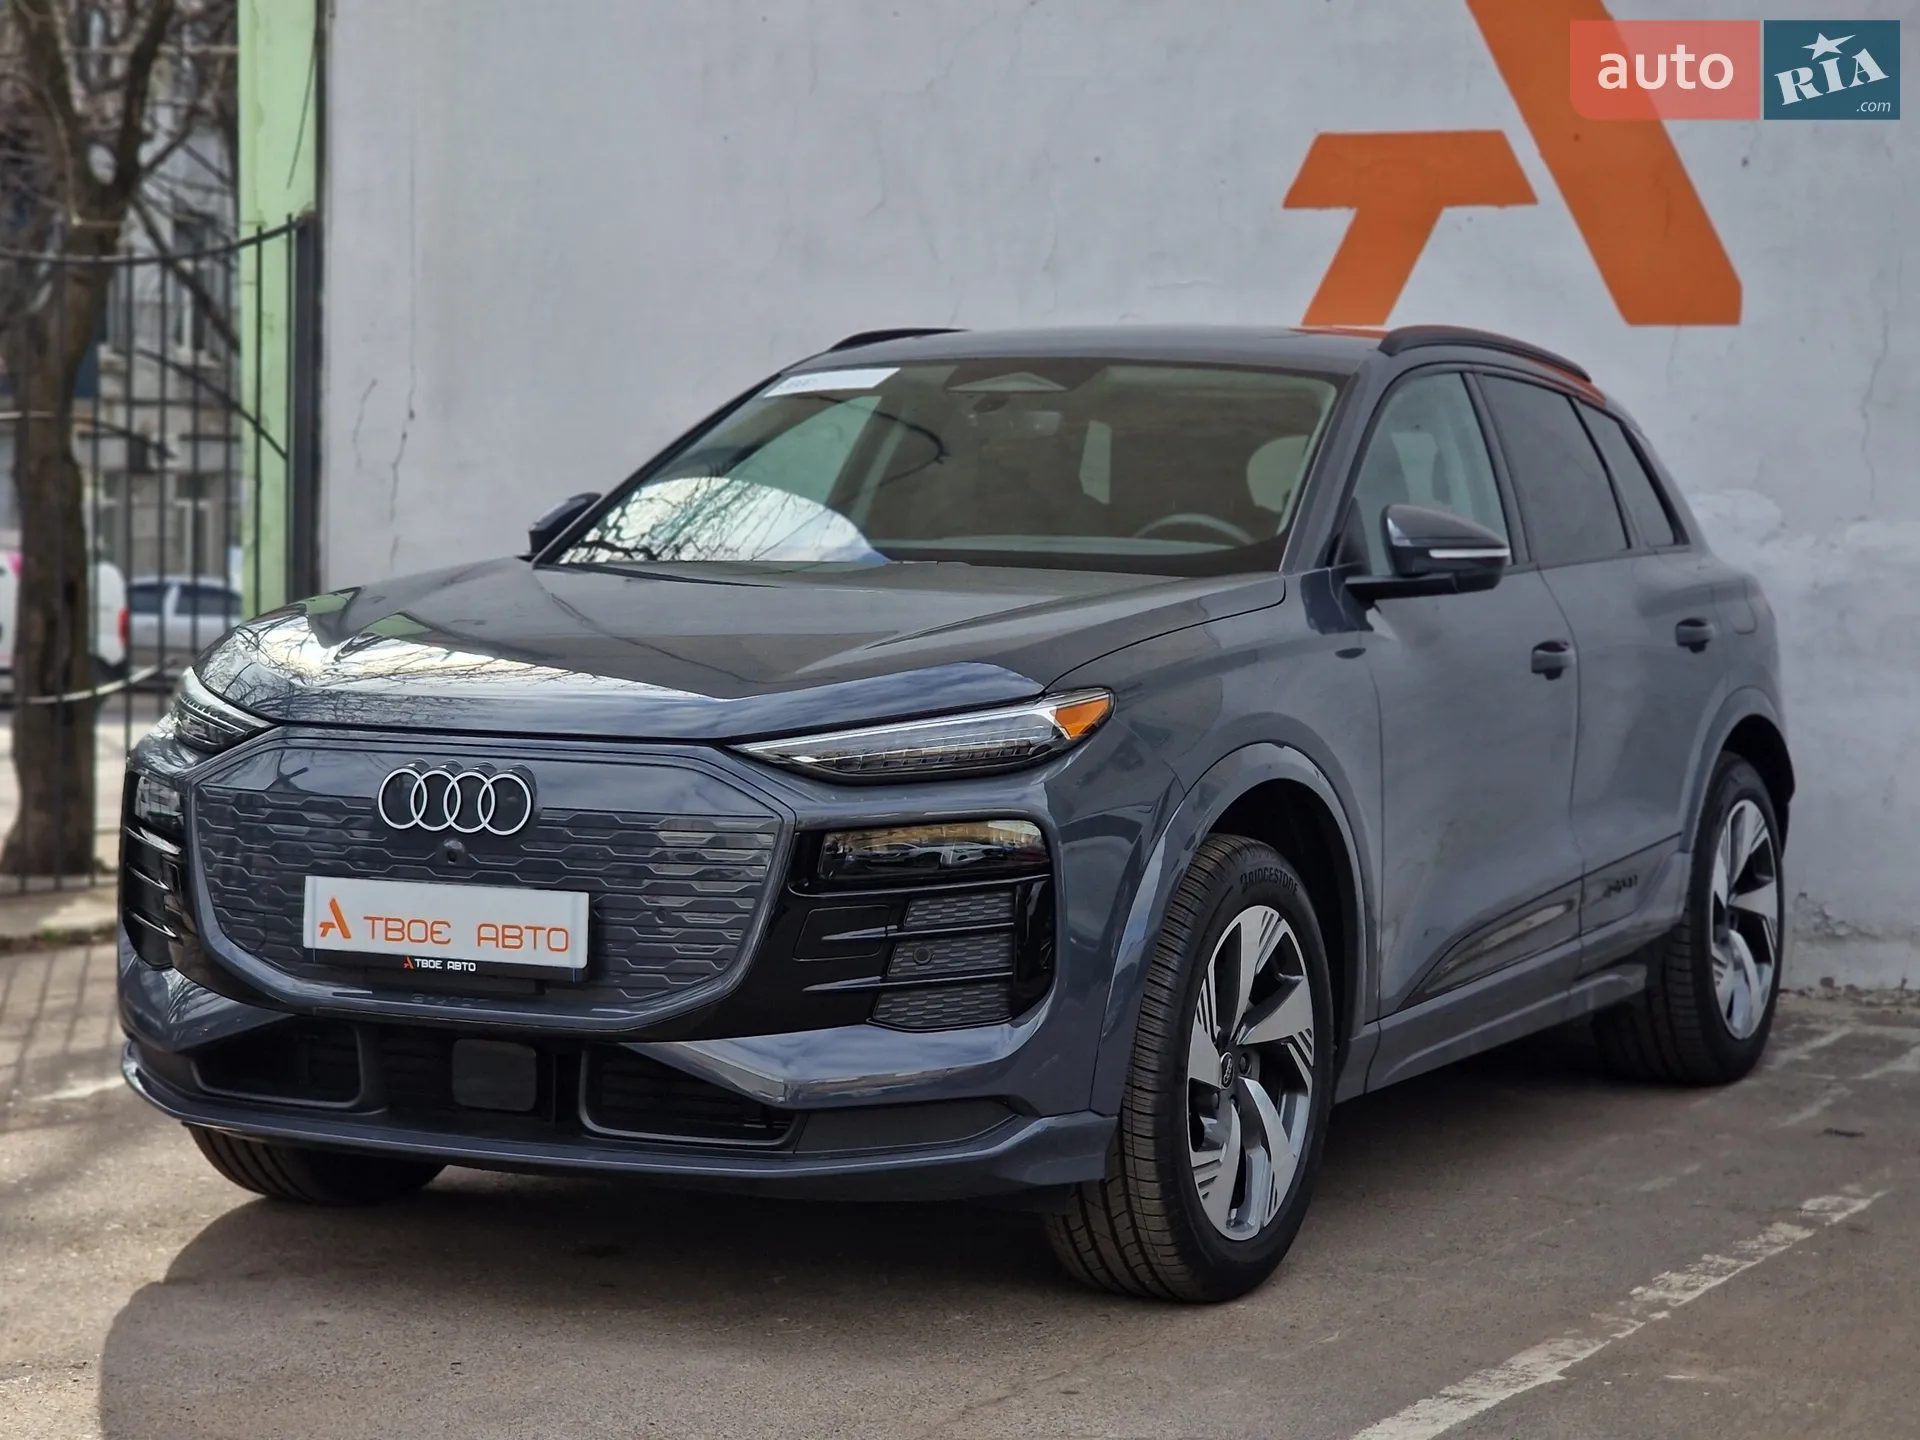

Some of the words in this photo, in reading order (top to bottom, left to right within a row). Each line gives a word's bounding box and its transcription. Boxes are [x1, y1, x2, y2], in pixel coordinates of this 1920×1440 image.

[1239, 866, 1299, 896] BRIDGESTONE
[477, 923, 569, 953] АВТО
[446, 961, 477, 972] АВТО
